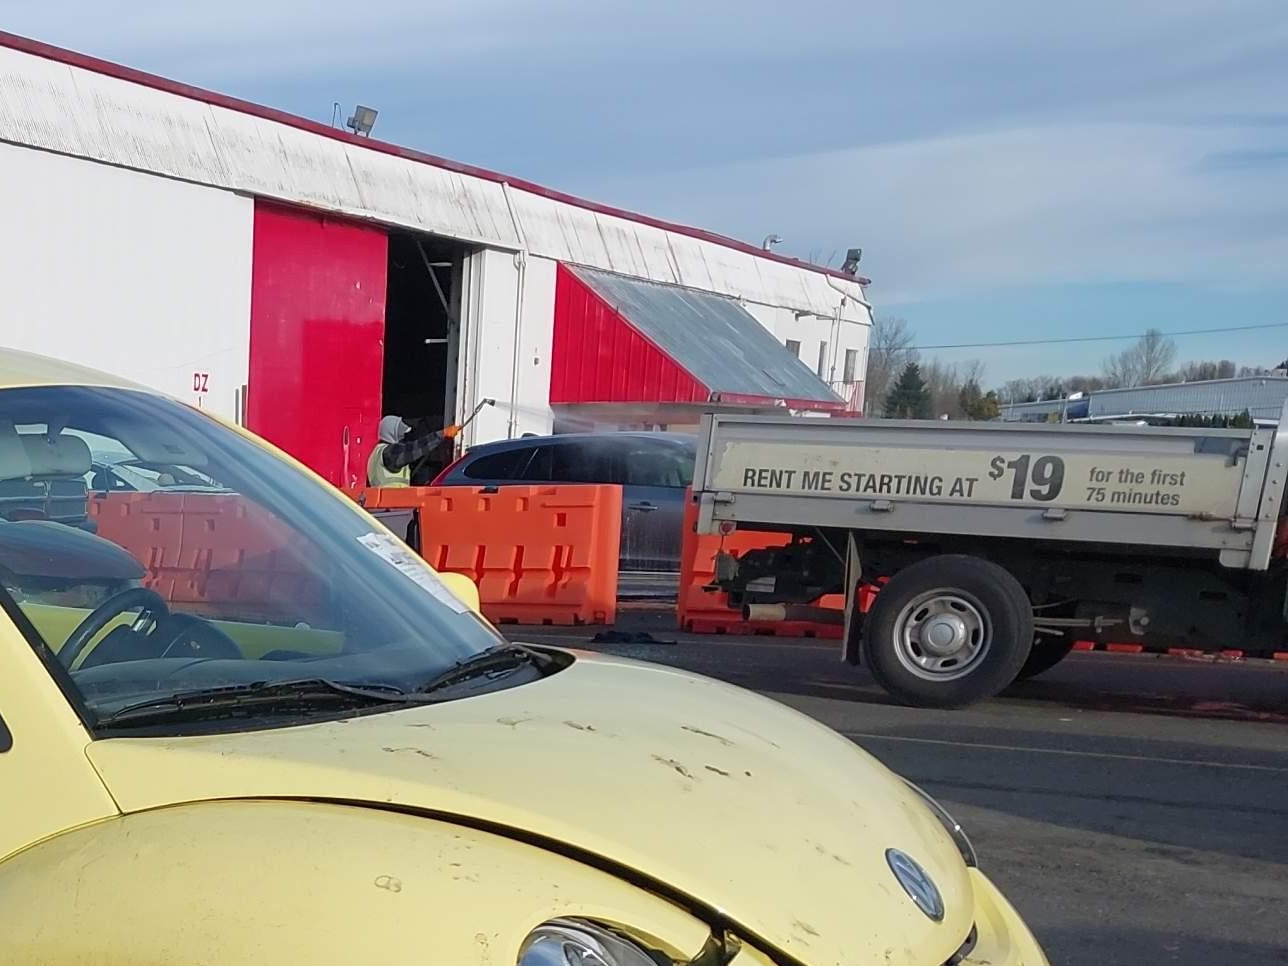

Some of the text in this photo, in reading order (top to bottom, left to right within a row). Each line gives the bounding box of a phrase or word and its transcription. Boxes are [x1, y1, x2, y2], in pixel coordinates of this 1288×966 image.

[193, 373, 209, 392] DZ
[743, 454, 1065, 502] RENT ME STARTING AT $19
[1089, 466, 1186, 486] for the first
[1086, 487, 1181, 506] 75 minutes
